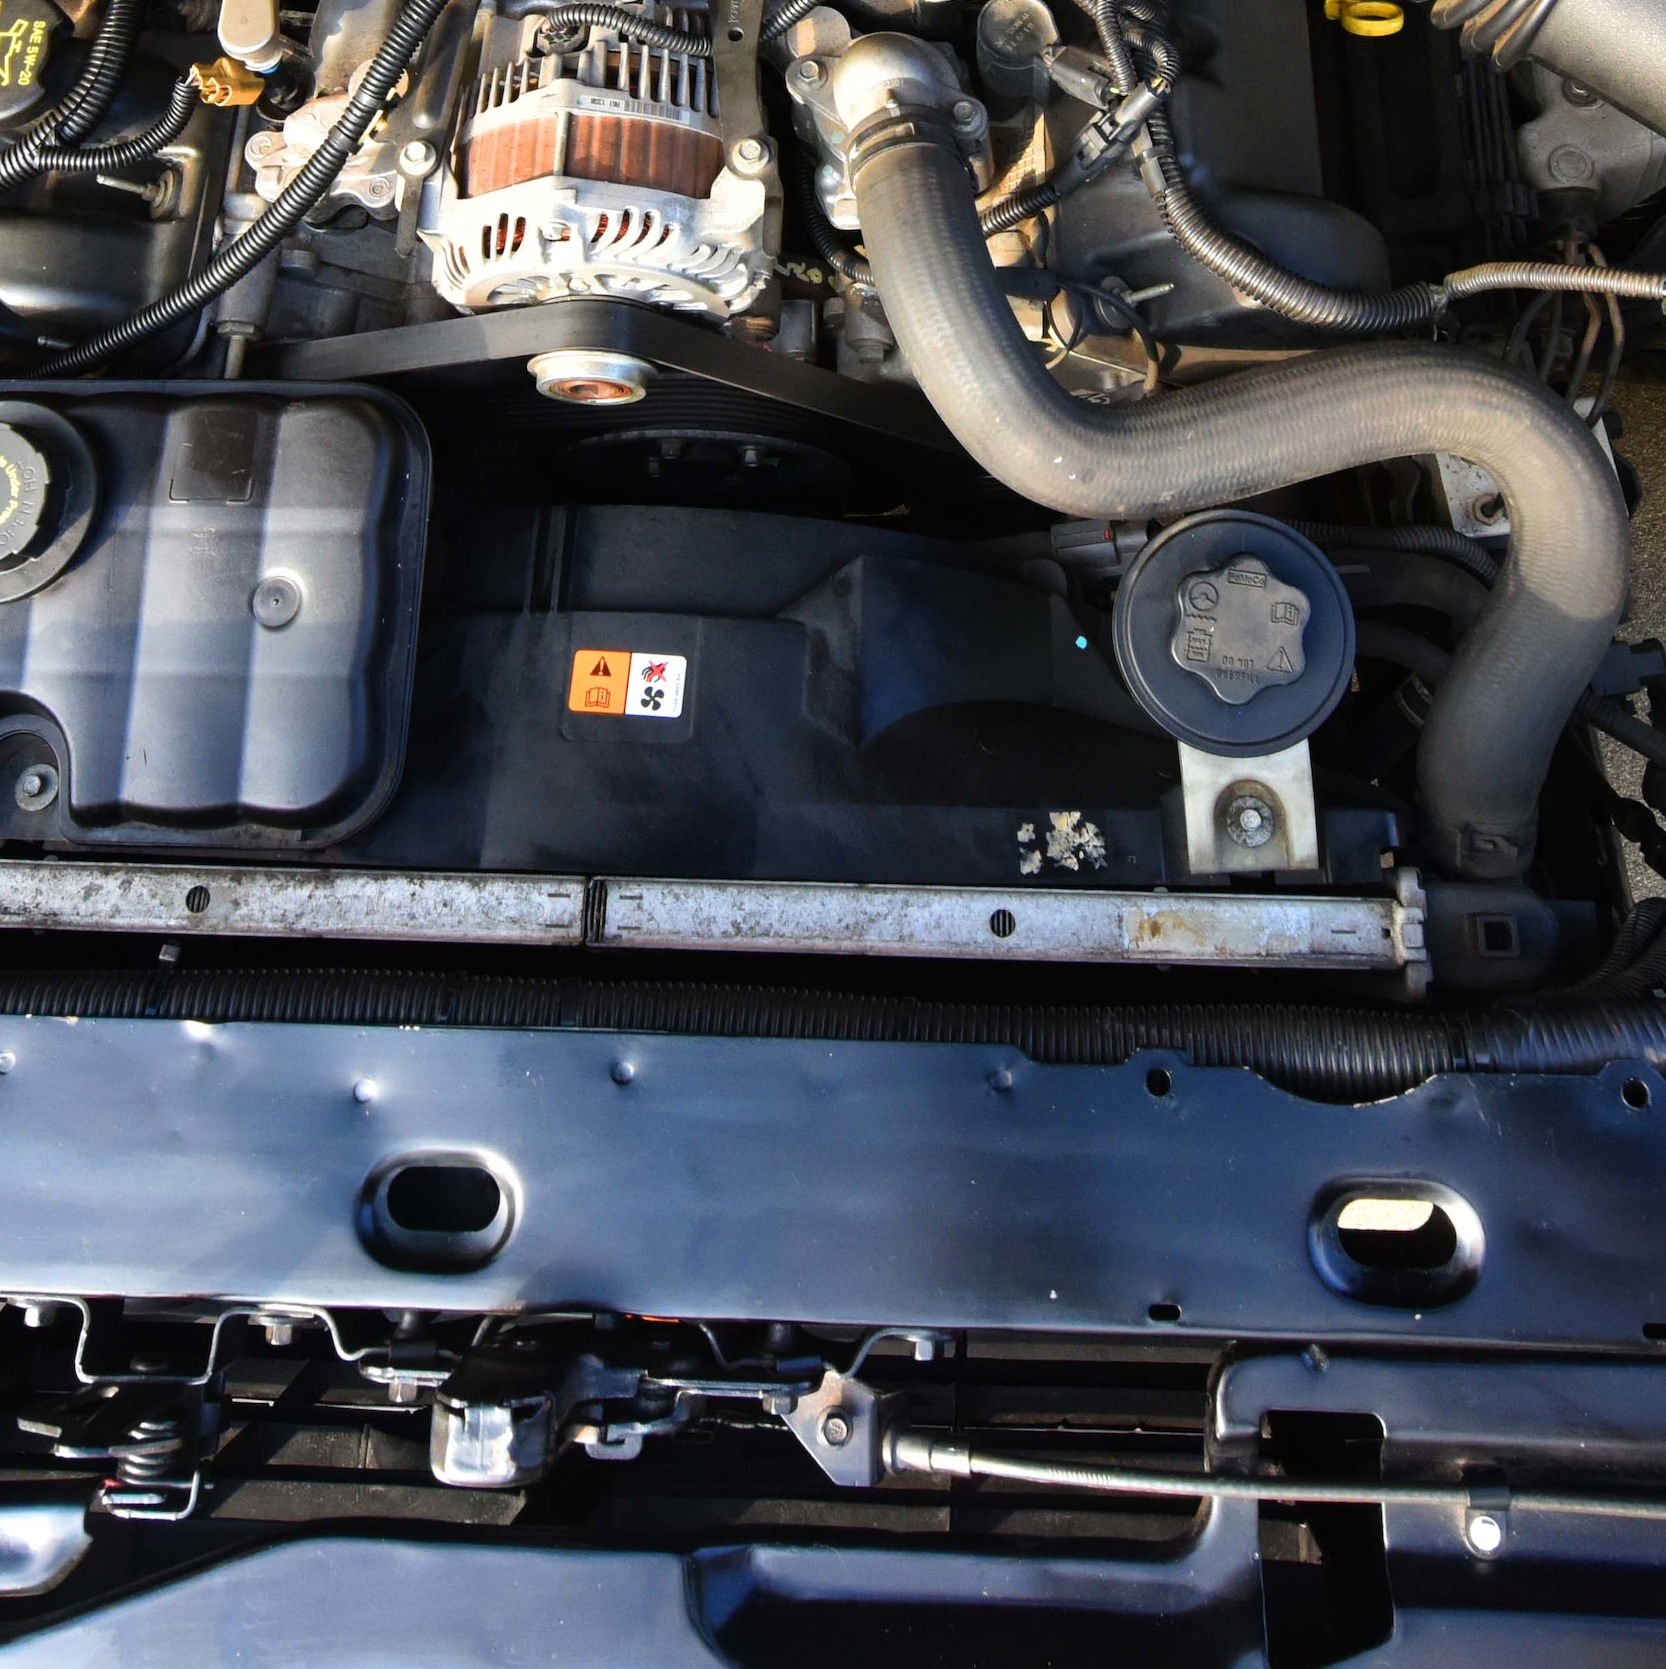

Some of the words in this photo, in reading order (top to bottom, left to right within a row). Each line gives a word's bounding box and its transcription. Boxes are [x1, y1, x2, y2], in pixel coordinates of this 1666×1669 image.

[30, 20, 47, 43] SAE
[17, 45, 39, 86] 5W-20
[5, 463, 22, 502] Under
